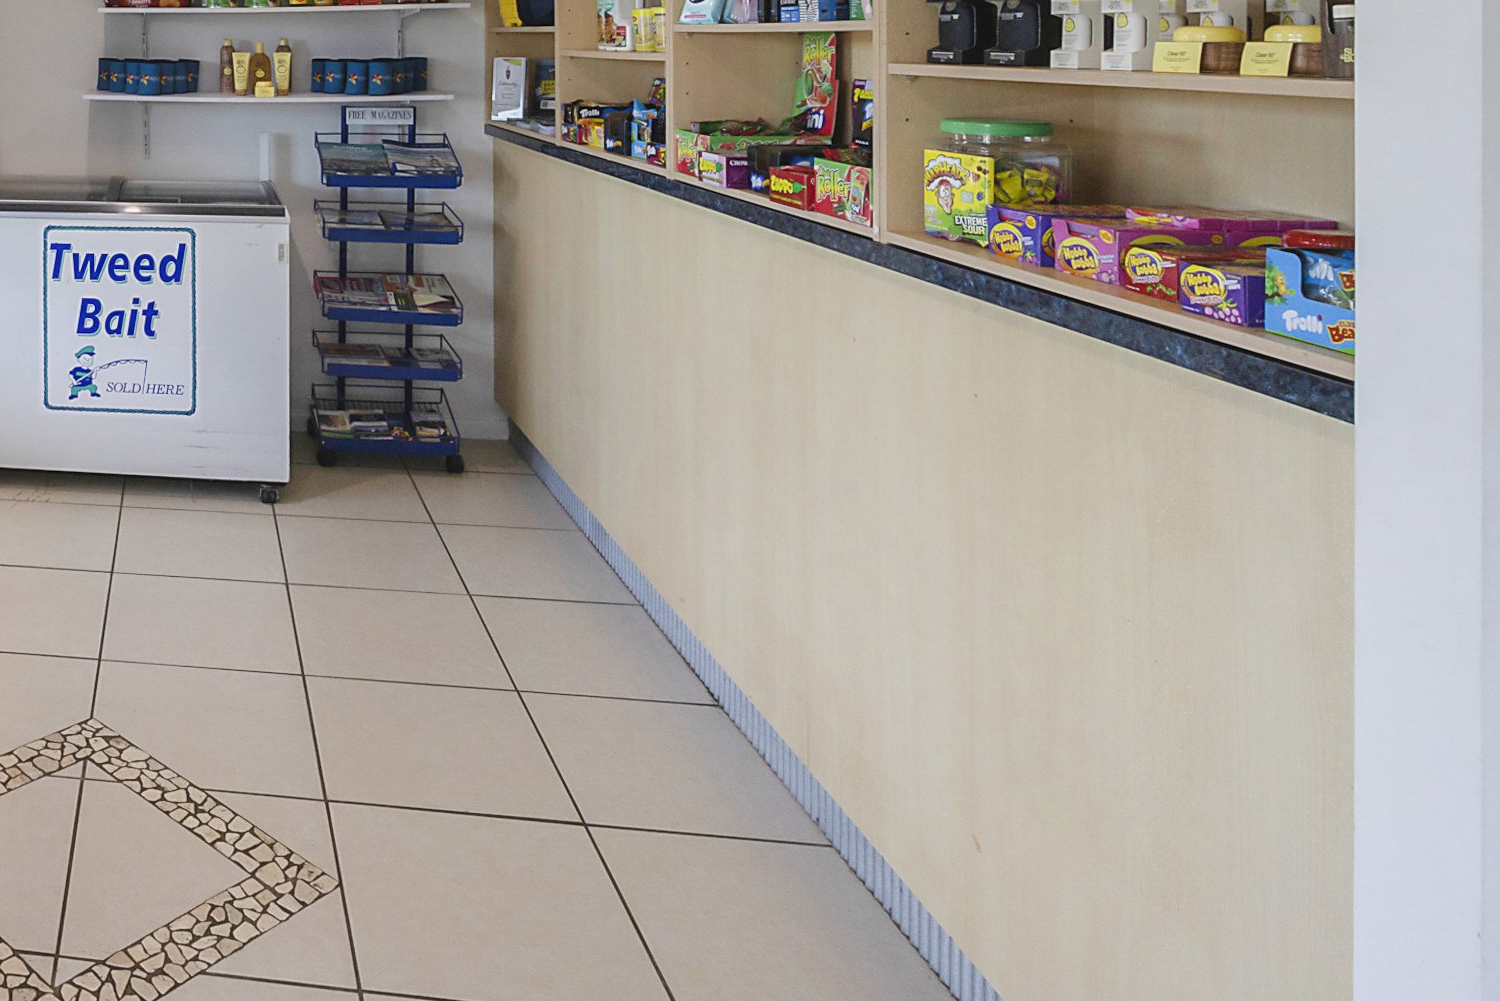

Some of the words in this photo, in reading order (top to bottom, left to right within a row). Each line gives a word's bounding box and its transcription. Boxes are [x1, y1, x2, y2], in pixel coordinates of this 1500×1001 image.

[348, 110, 367, 120] FREE
[371, 110, 412, 120] MAGAZINES
[816, 172, 850, 203] Roller
[954, 215, 987, 227] EXTREME
[962, 224, 985, 236] SOUR
[50, 243, 188, 285] Tweed
[76, 297, 160, 339] Bait
[1282, 309, 1323, 335] Trolli
[1327, 324, 1355, 344] Bea
[106, 382, 141, 394] SOLD
[145, 382, 185, 396] HERE
